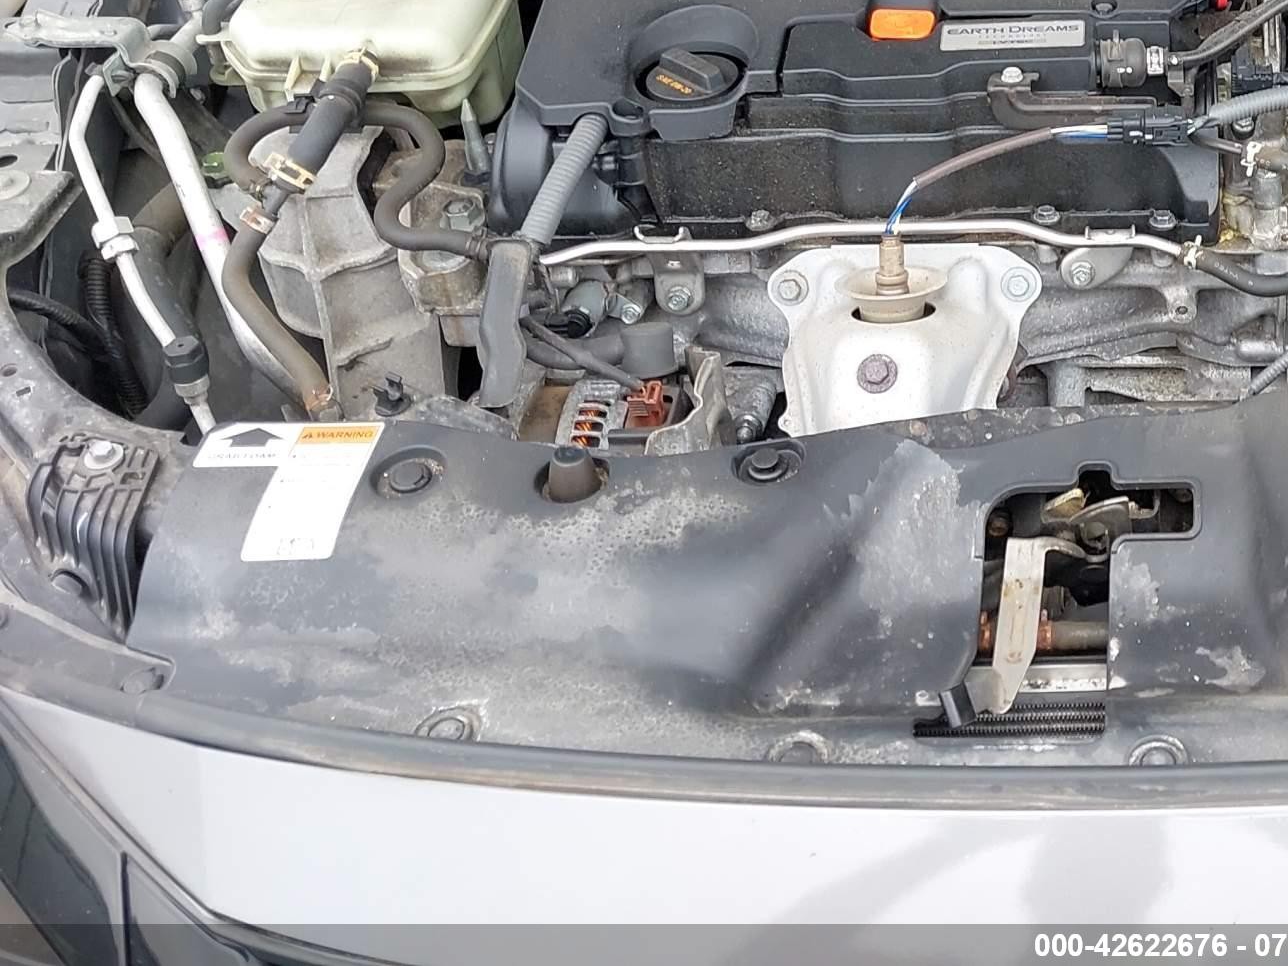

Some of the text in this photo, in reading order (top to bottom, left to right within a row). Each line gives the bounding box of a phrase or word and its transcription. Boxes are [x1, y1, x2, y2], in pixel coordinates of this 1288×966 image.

[947, 25, 1079, 35] EARTH DREAMS
[315, 430, 374, 440] WARNING
